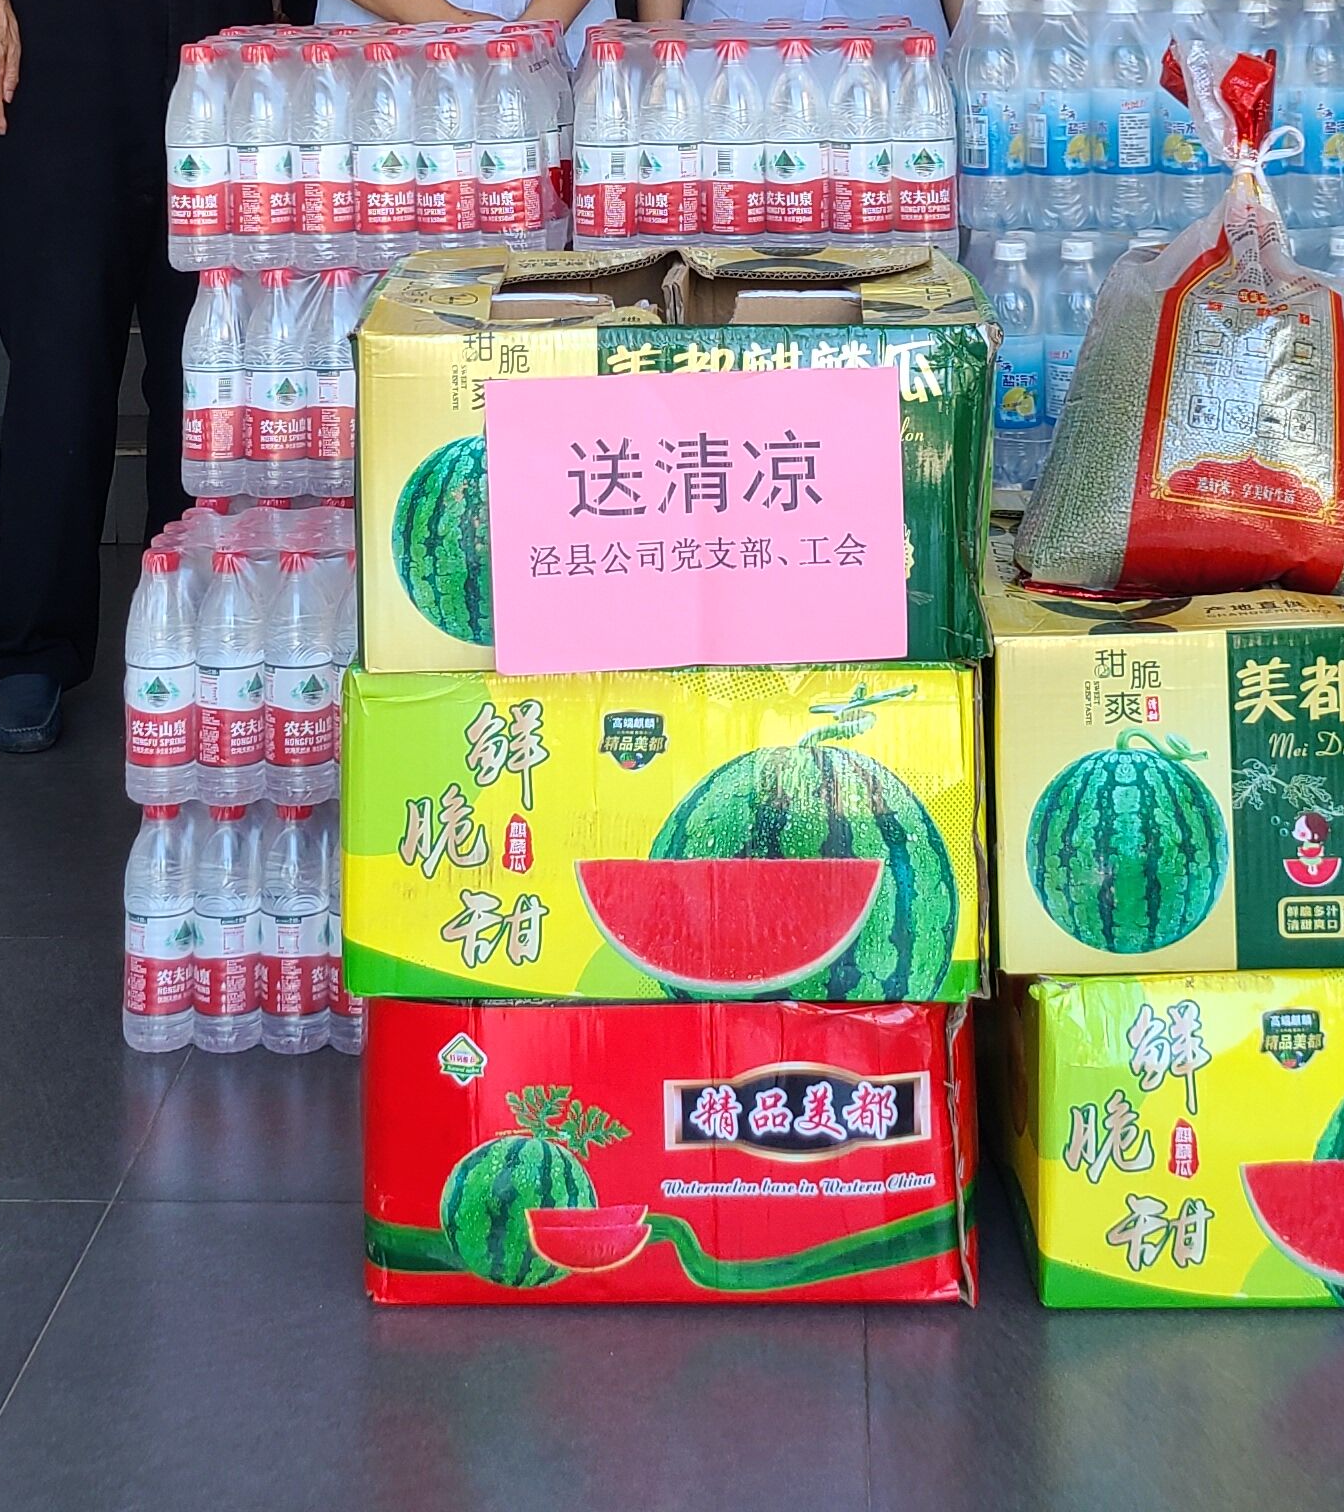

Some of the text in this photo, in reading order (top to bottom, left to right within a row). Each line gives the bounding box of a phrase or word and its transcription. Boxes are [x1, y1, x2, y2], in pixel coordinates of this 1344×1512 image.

[170, 193, 218, 209] 农夫山泉
[899, 189, 950, 205] 农夫山泉
[566, 429, 824, 519] 送清凉
[529, 532, 868, 578] 泾县公司党支部、工会
[131, 720, 187, 737] 农夫山泉
[603, 735, 665, 752] 精品美都
[1269, 733, 1309, 759] Mei
[1286, 905, 1338, 918] 鲜脆多汁
[1286, 919, 1338, 931] 清甜爽口
[1264, 1033, 1323, 1050] 精品美都
[689, 1080, 901, 1143] 精品美都
[662, 1177, 758, 1197] Watermelon
[798, 1179, 817, 1195] in
[820, 1177, 885, 1196] Western
[886, 1172, 936, 1191] China
